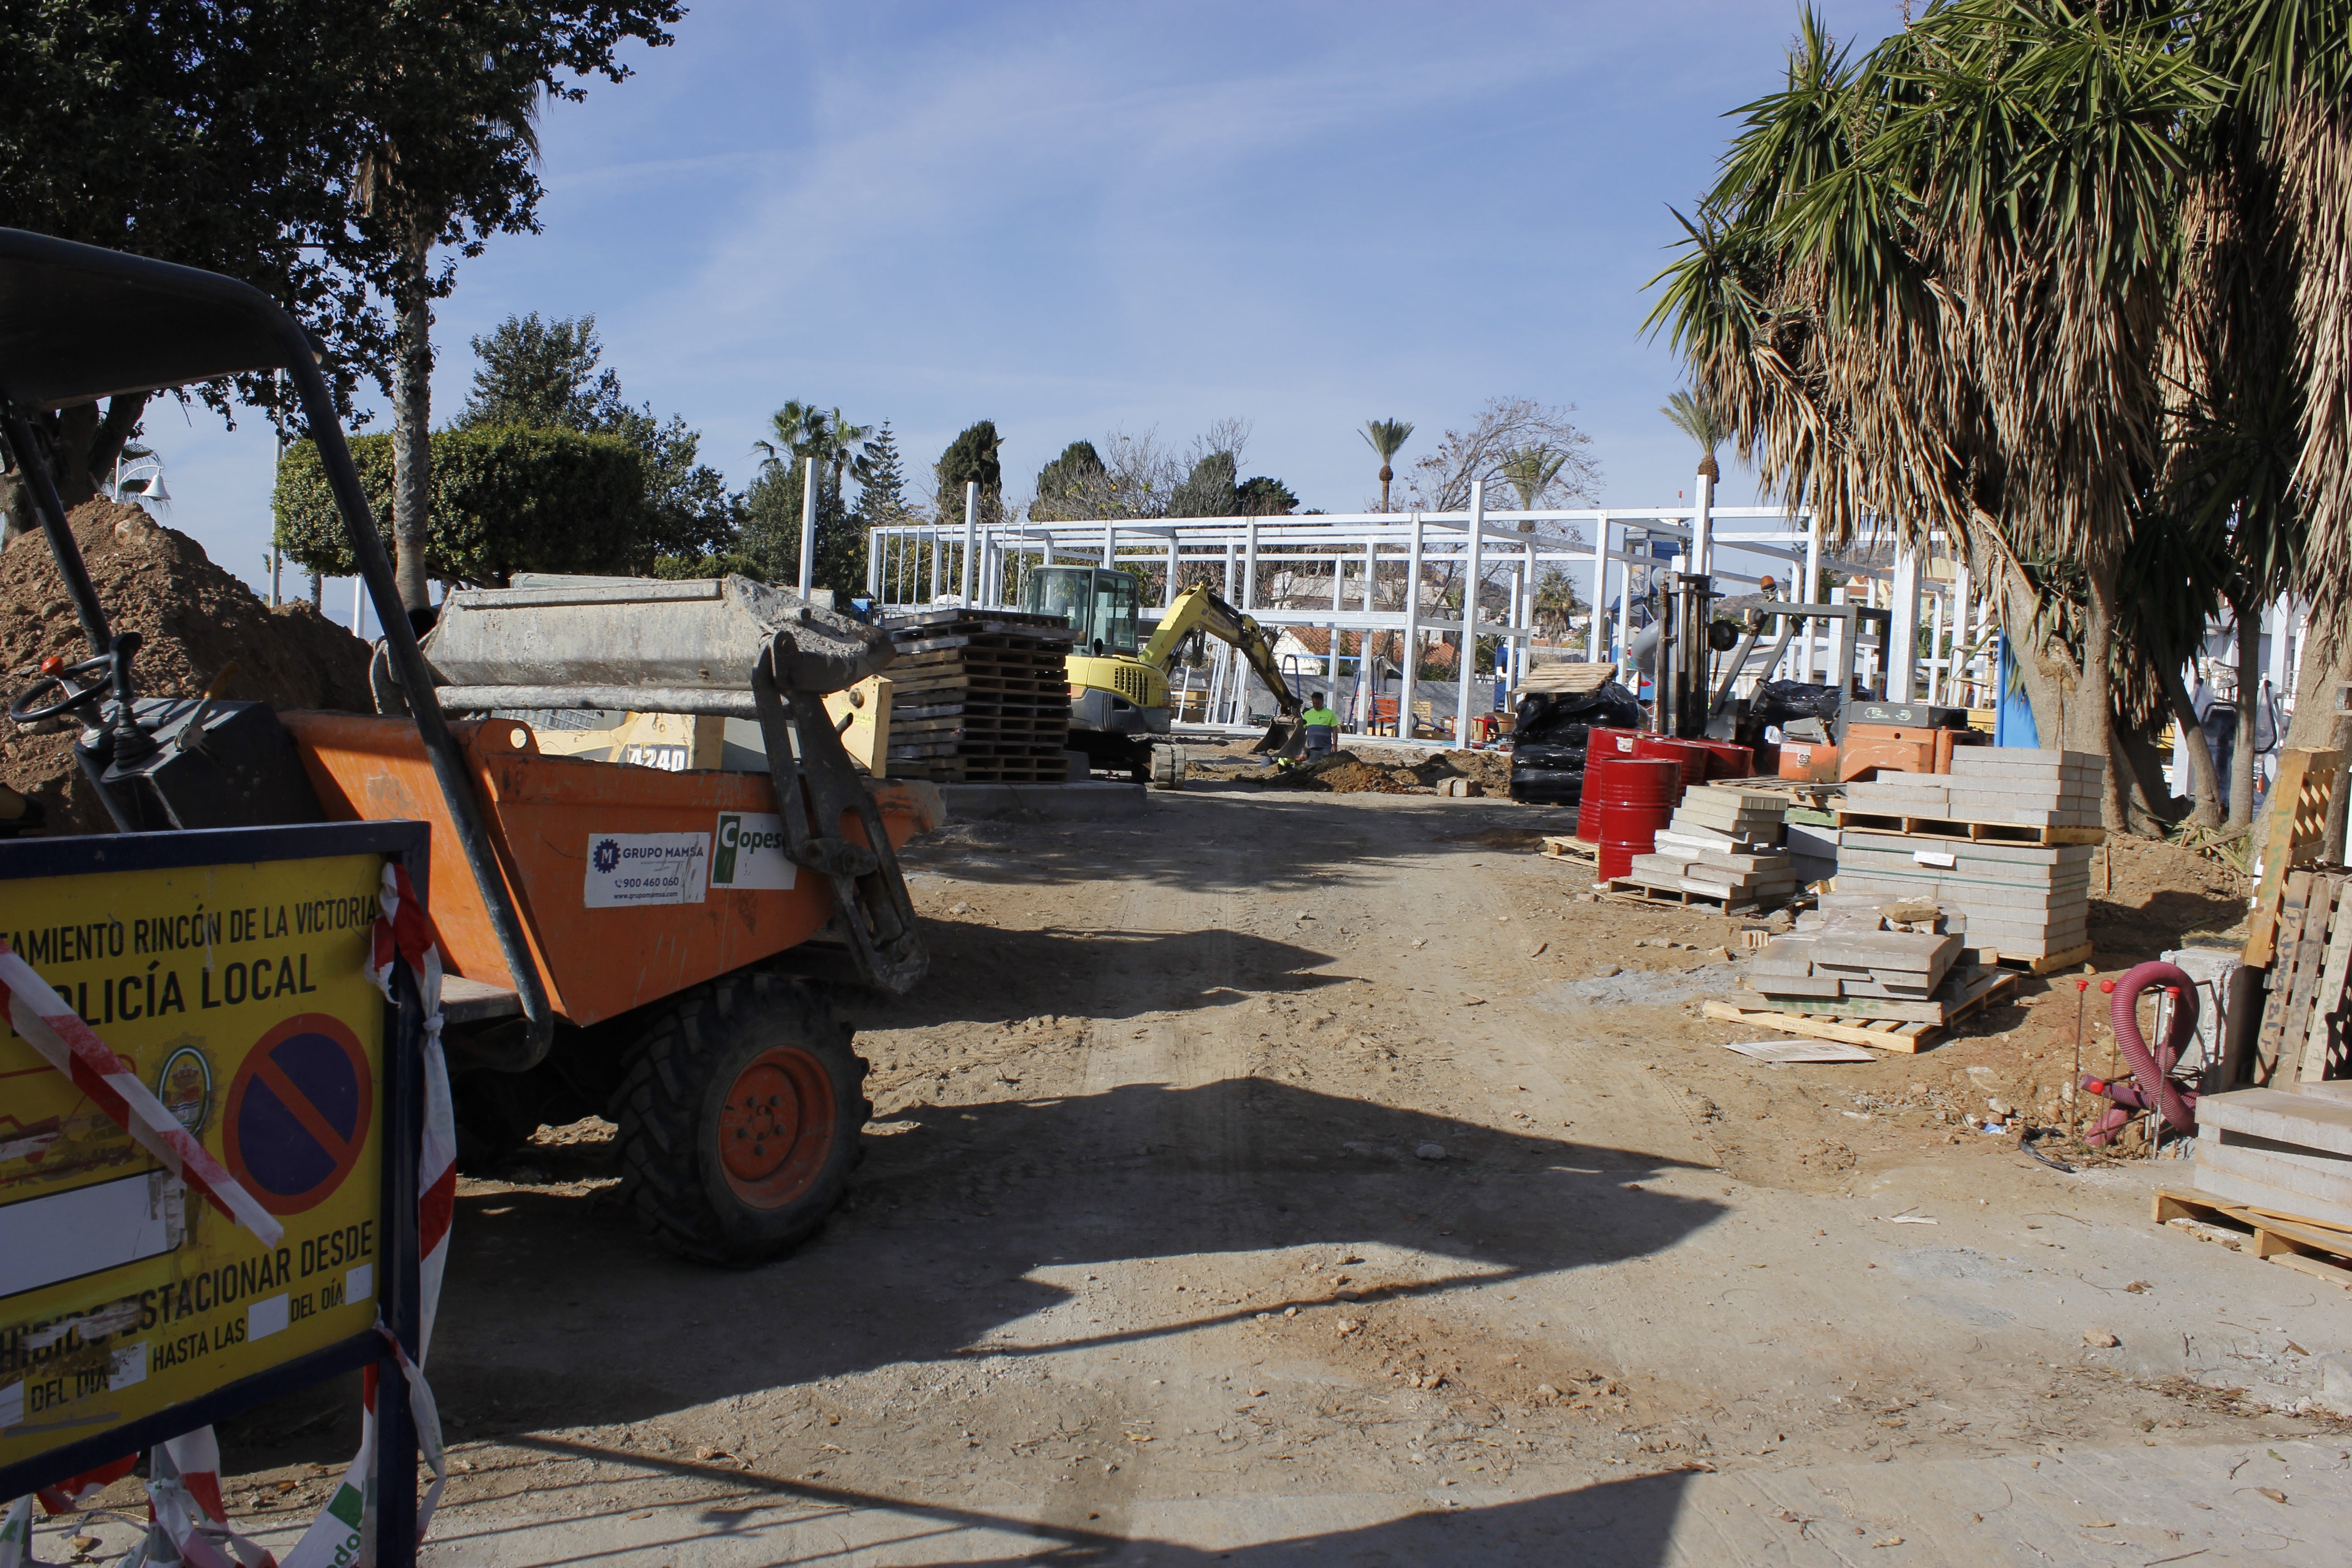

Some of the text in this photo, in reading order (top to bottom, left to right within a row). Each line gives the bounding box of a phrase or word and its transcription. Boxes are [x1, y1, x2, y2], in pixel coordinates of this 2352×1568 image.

[629, 749, 686, 772] 4240
[623, 846, 704, 859] GRUPO MAMSA
[614, 892, 678, 900] www.grupomamsa.com
[623, 877, 679, 888] 900 460 060
[135, 903, 221, 954] RINCÓN
[230, 908, 257, 943] DE
[264, 905, 289, 938] LA
[295, 895, 377, 935] VICTORIA
[49, 953, 317, 1028] LICÍA LOCAL
[301, 1220, 373, 1278] DESDE
[31, 1278, 344, 1413] DEL DÍA HASTA LAS DEL DÍA
